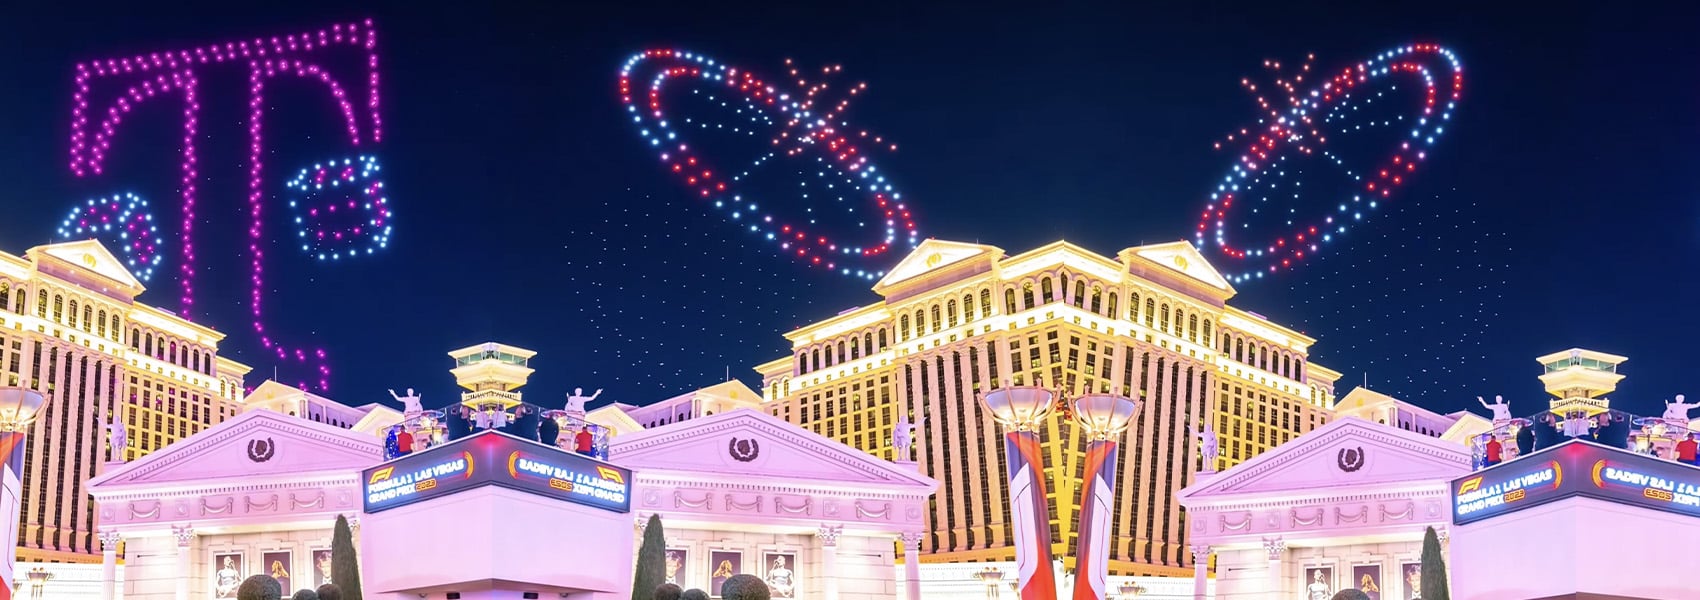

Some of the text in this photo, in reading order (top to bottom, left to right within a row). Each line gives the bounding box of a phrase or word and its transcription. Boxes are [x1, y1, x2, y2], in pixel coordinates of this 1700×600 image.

[368, 466, 395, 484] F1
[368, 459, 464, 494] FORMULA 1 LAS VEGAS
[1457, 487, 1496, 505] FORMULA
[1503, 478, 1521, 491] LAS
[1520, 468, 1553, 486] VEGAS
[1458, 476, 1483, 495] F1
[368, 480, 436, 503] GRAND PRIX 2023
[1457, 490, 1525, 515] GRAND PRIX 2023
